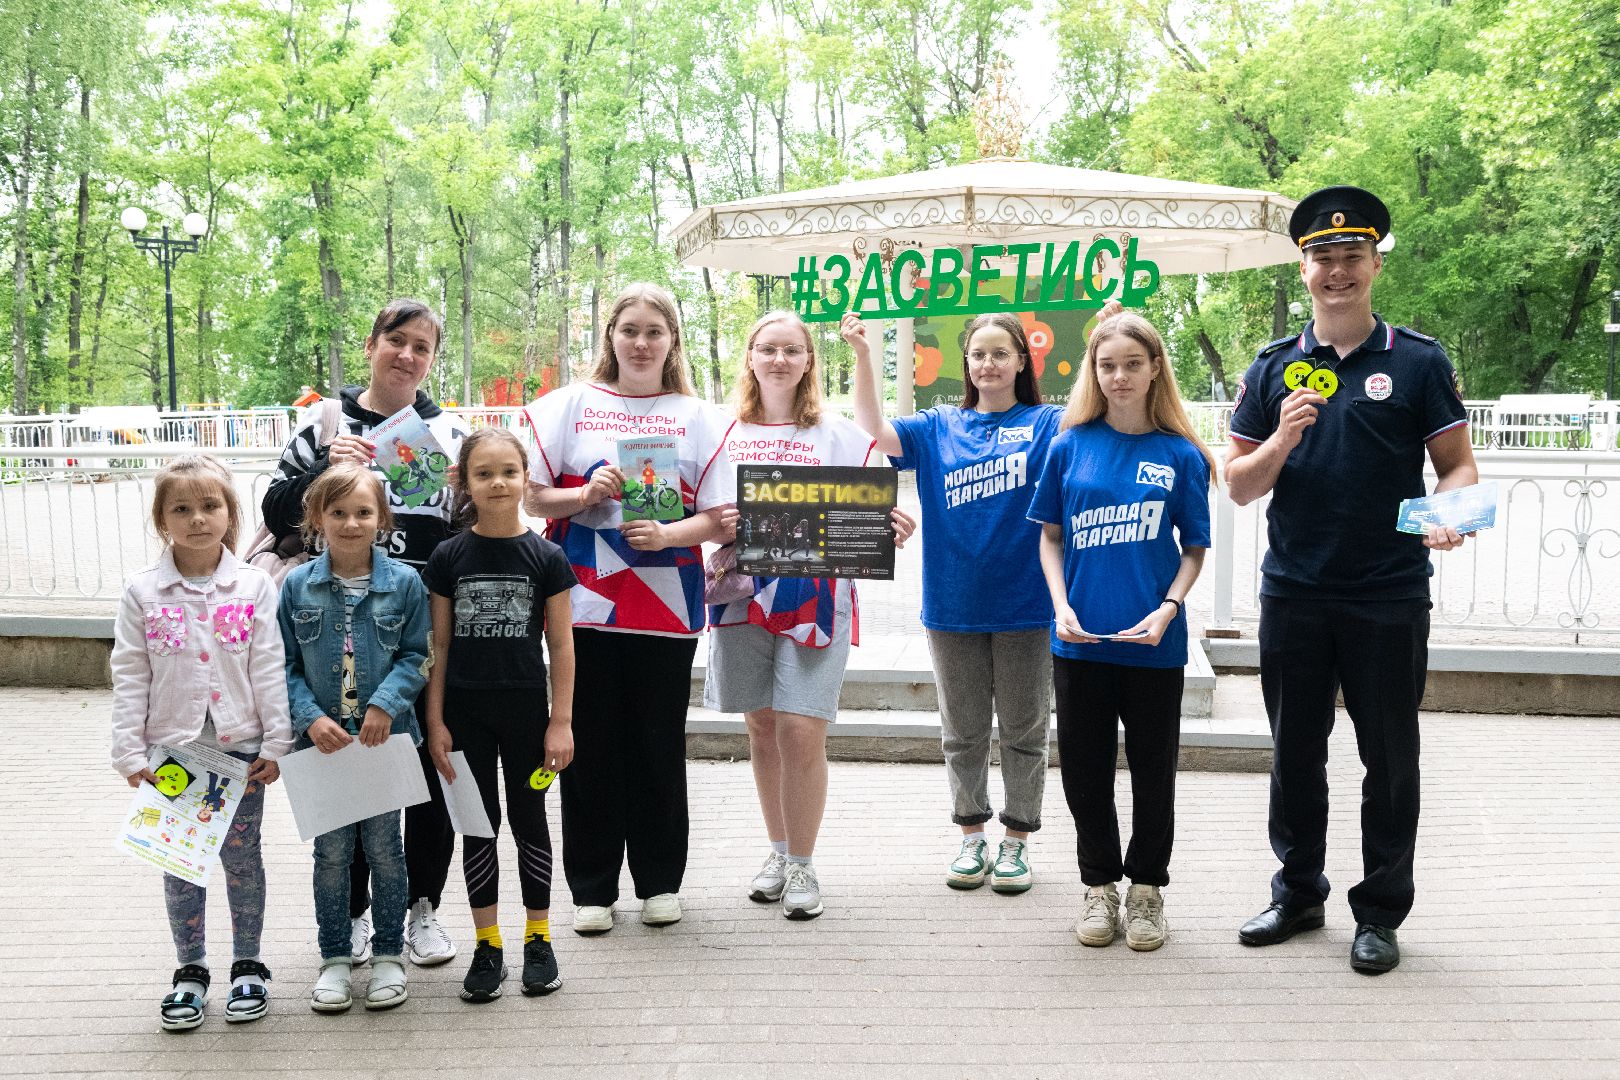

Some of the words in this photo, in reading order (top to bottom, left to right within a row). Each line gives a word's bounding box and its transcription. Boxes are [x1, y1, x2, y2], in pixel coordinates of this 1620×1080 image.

[791, 237, 1160, 322] #ЗАСВЕТИСЬ
[575, 421, 686, 437] ПОДМОСКОВЬЯ
[944, 452, 1027, 490] МОЛОДАЯ
[1071, 501, 1165, 539] МОЛОДАЯ
[454, 624, 471, 637] OLD
[473, 623, 529, 638] SCHOOL
